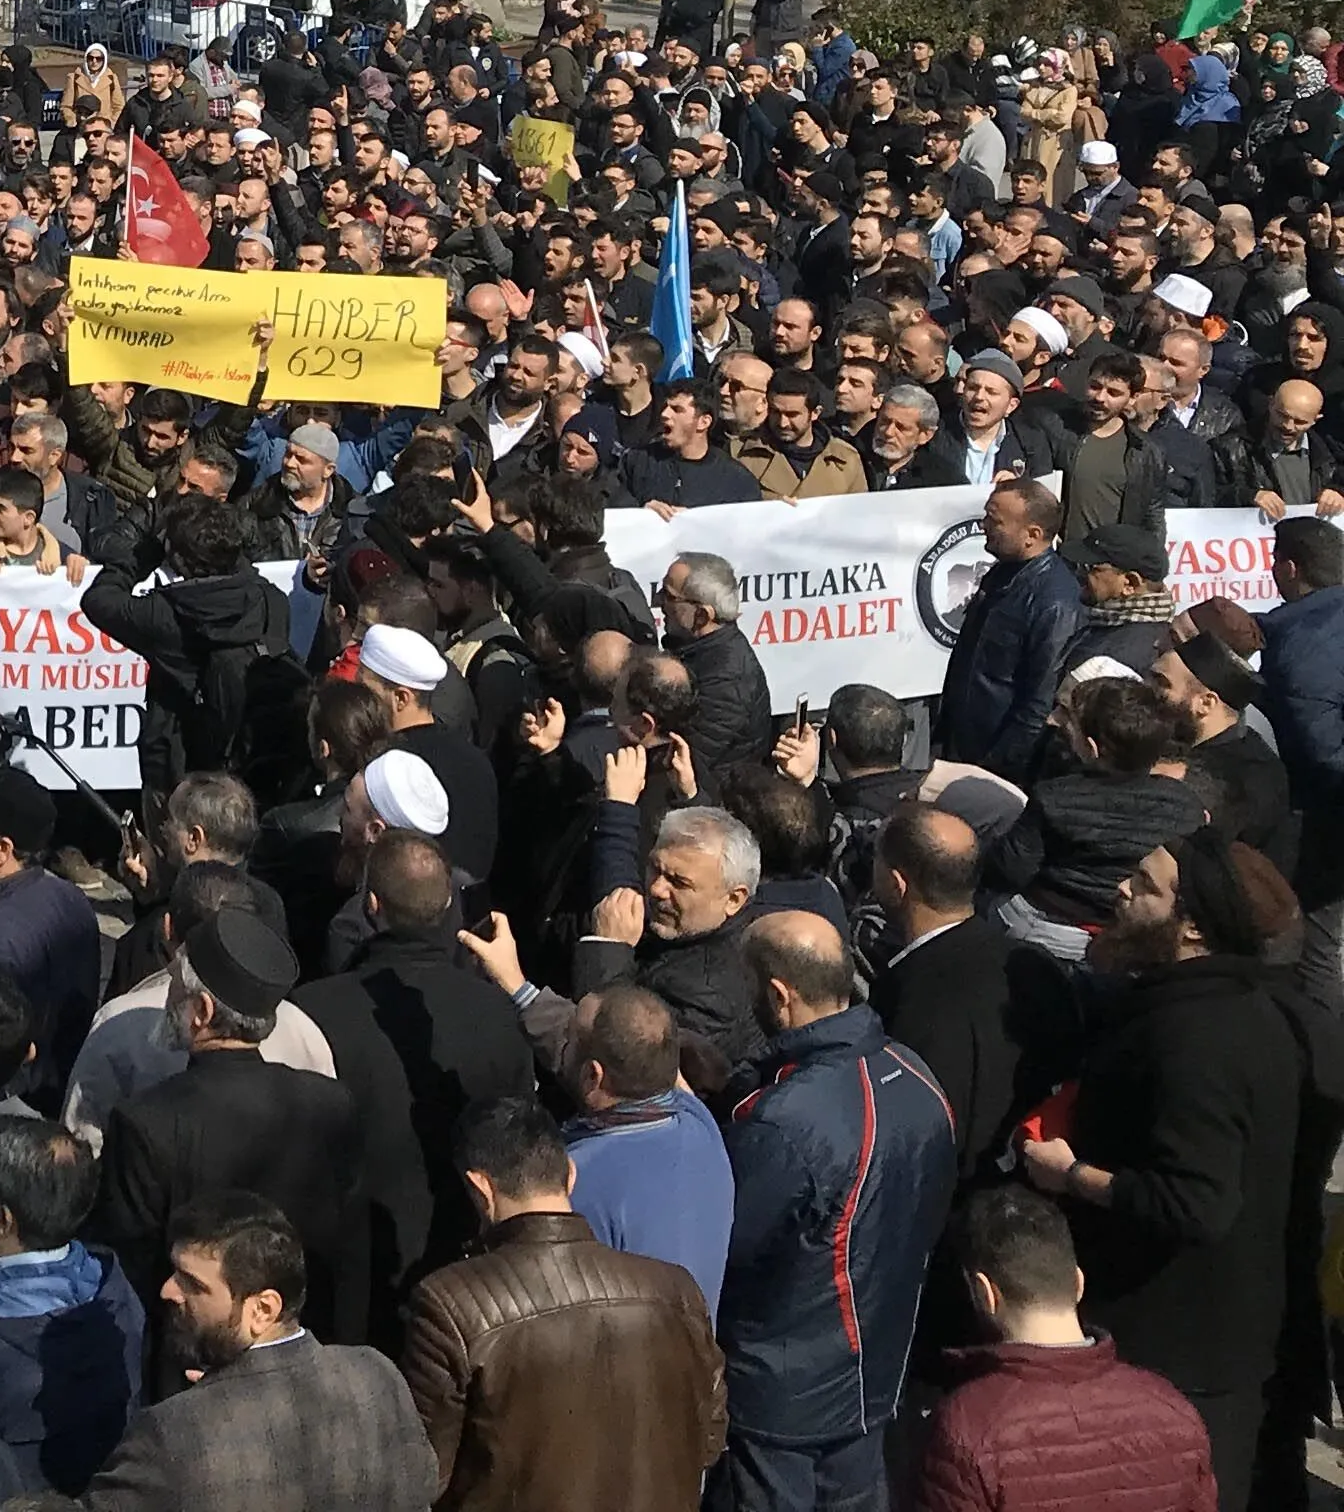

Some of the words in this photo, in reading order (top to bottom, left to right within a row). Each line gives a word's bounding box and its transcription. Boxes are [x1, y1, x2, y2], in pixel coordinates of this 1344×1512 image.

[272, 287, 424, 349] HAYBER
[287, 347, 364, 380] 629
[752, 598, 903, 645] ADALET
